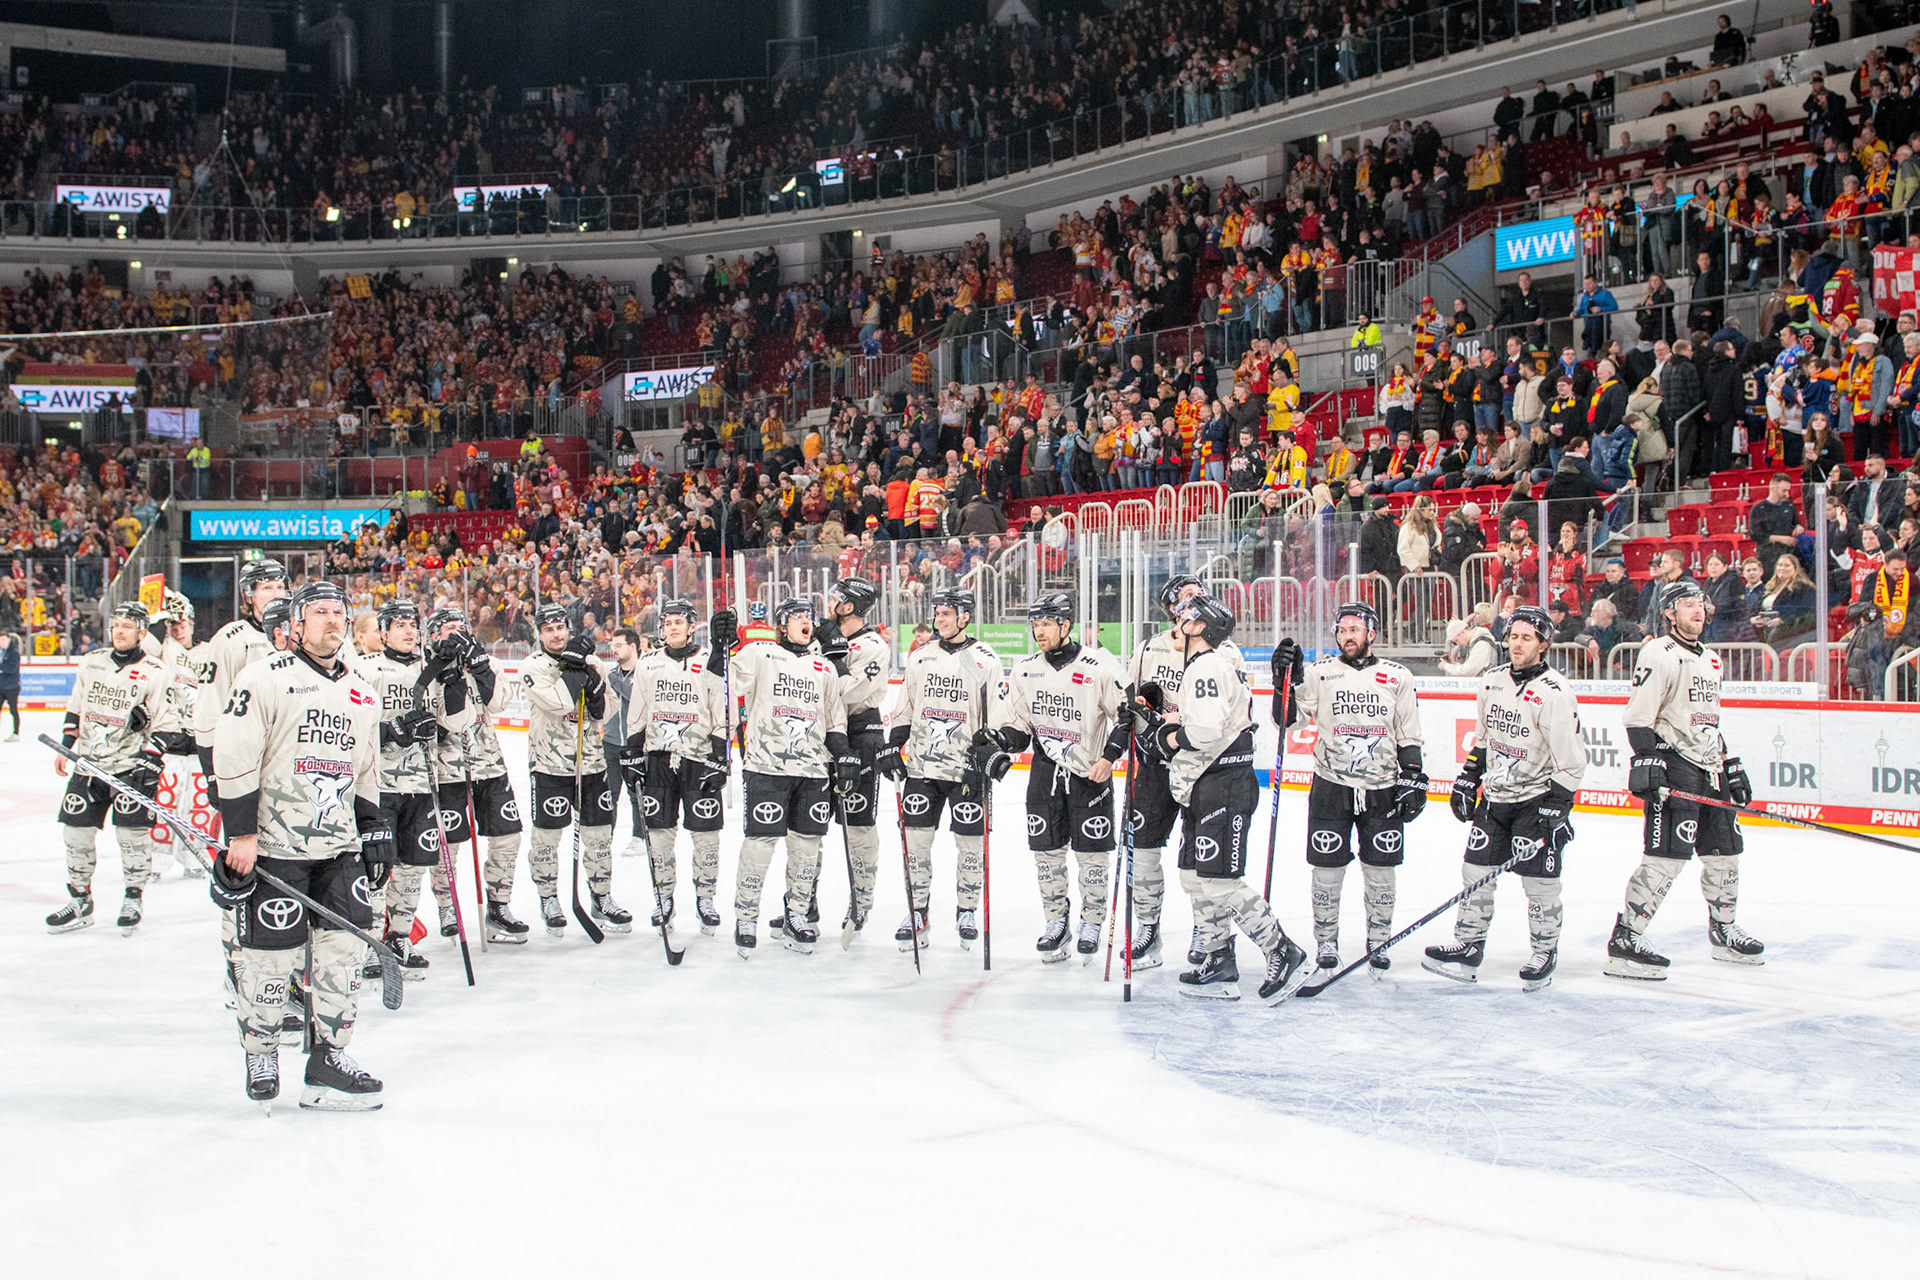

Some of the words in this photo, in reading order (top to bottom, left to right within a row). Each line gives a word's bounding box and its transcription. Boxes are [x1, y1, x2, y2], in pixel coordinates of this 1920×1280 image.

[93, 191, 165, 209] AWISTA
[1354, 352, 1378, 373] 009
[656, 371, 714, 394] AWIST
[778, 671, 815, 692] Rhein
[926, 672, 963, 690] Rhein
[1156, 664, 1183, 683] Rhe
[92, 680, 127, 700] Rhein
[130, 684, 138, 698] C
[388, 684, 430, 698] Rhen
[656, 679, 692, 692] Rhein
[773, 683, 820, 704] Energie
[924, 684, 969, 703] Energie
[1194, 677, 1220, 699] 89
[87, 690, 132, 711] Energie
[654, 690, 699, 705] Energie
[1036, 690, 1074, 708] Rhein
[1336, 689, 1380, 704] Rhein
[1031, 701, 1082, 723] Energie
[1331, 701, 1388, 718] Energie
[306, 708, 353, 734] Rhein
[1486, 714, 1530, 738] Energie
[295, 756, 339, 773] KÖLNER
[1769, 761, 1818, 790] IDR
[1871, 766, 1920, 795] IDR
[1870, 809, 1920, 828] PENN
[1651, 811, 1663, 849] TOYOTA
[1230, 832, 1241, 873] TOYOTA
[1084, 877, 1106, 887] Bank
[264, 982, 286, 996] psd
[255, 993, 286, 1006] Bank
